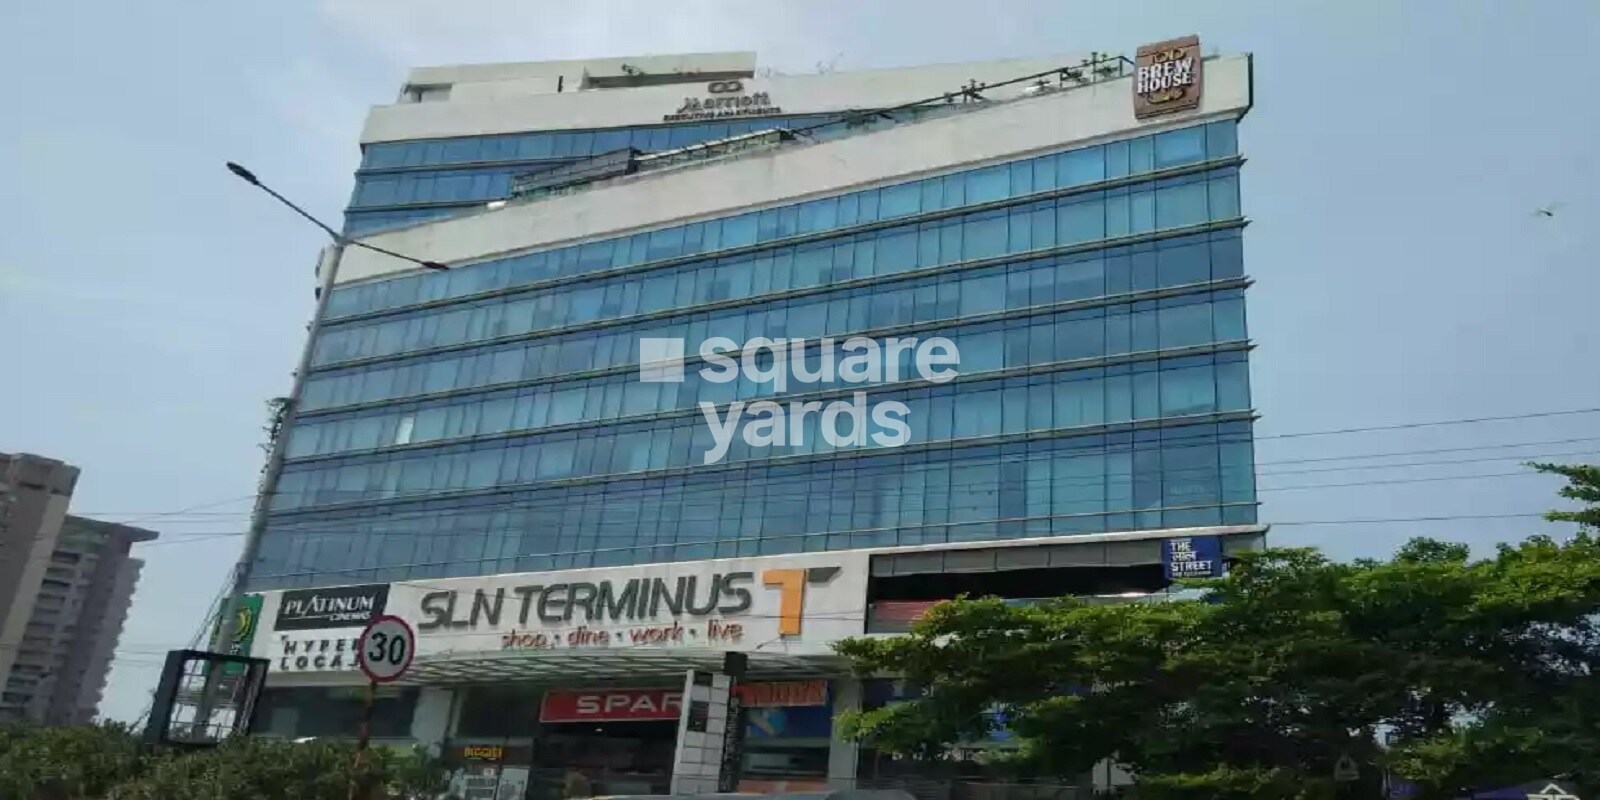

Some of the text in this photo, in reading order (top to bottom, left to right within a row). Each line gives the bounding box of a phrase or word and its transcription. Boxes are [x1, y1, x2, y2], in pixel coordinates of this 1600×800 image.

[1137, 56, 1193, 80] BREW
[1137, 71, 1193, 93] HOUSE
[1170, 541, 1192, 552] THE
[1170, 560, 1213, 572] STREET
[284, 595, 374, 615] PLATINUM
[417, 572, 754, 629] SLN TERMINUS
[503, 619, 745, 648] shop dine work live
[368, 632, 405, 666] 30
[577, 692, 684, 714] SPAR
